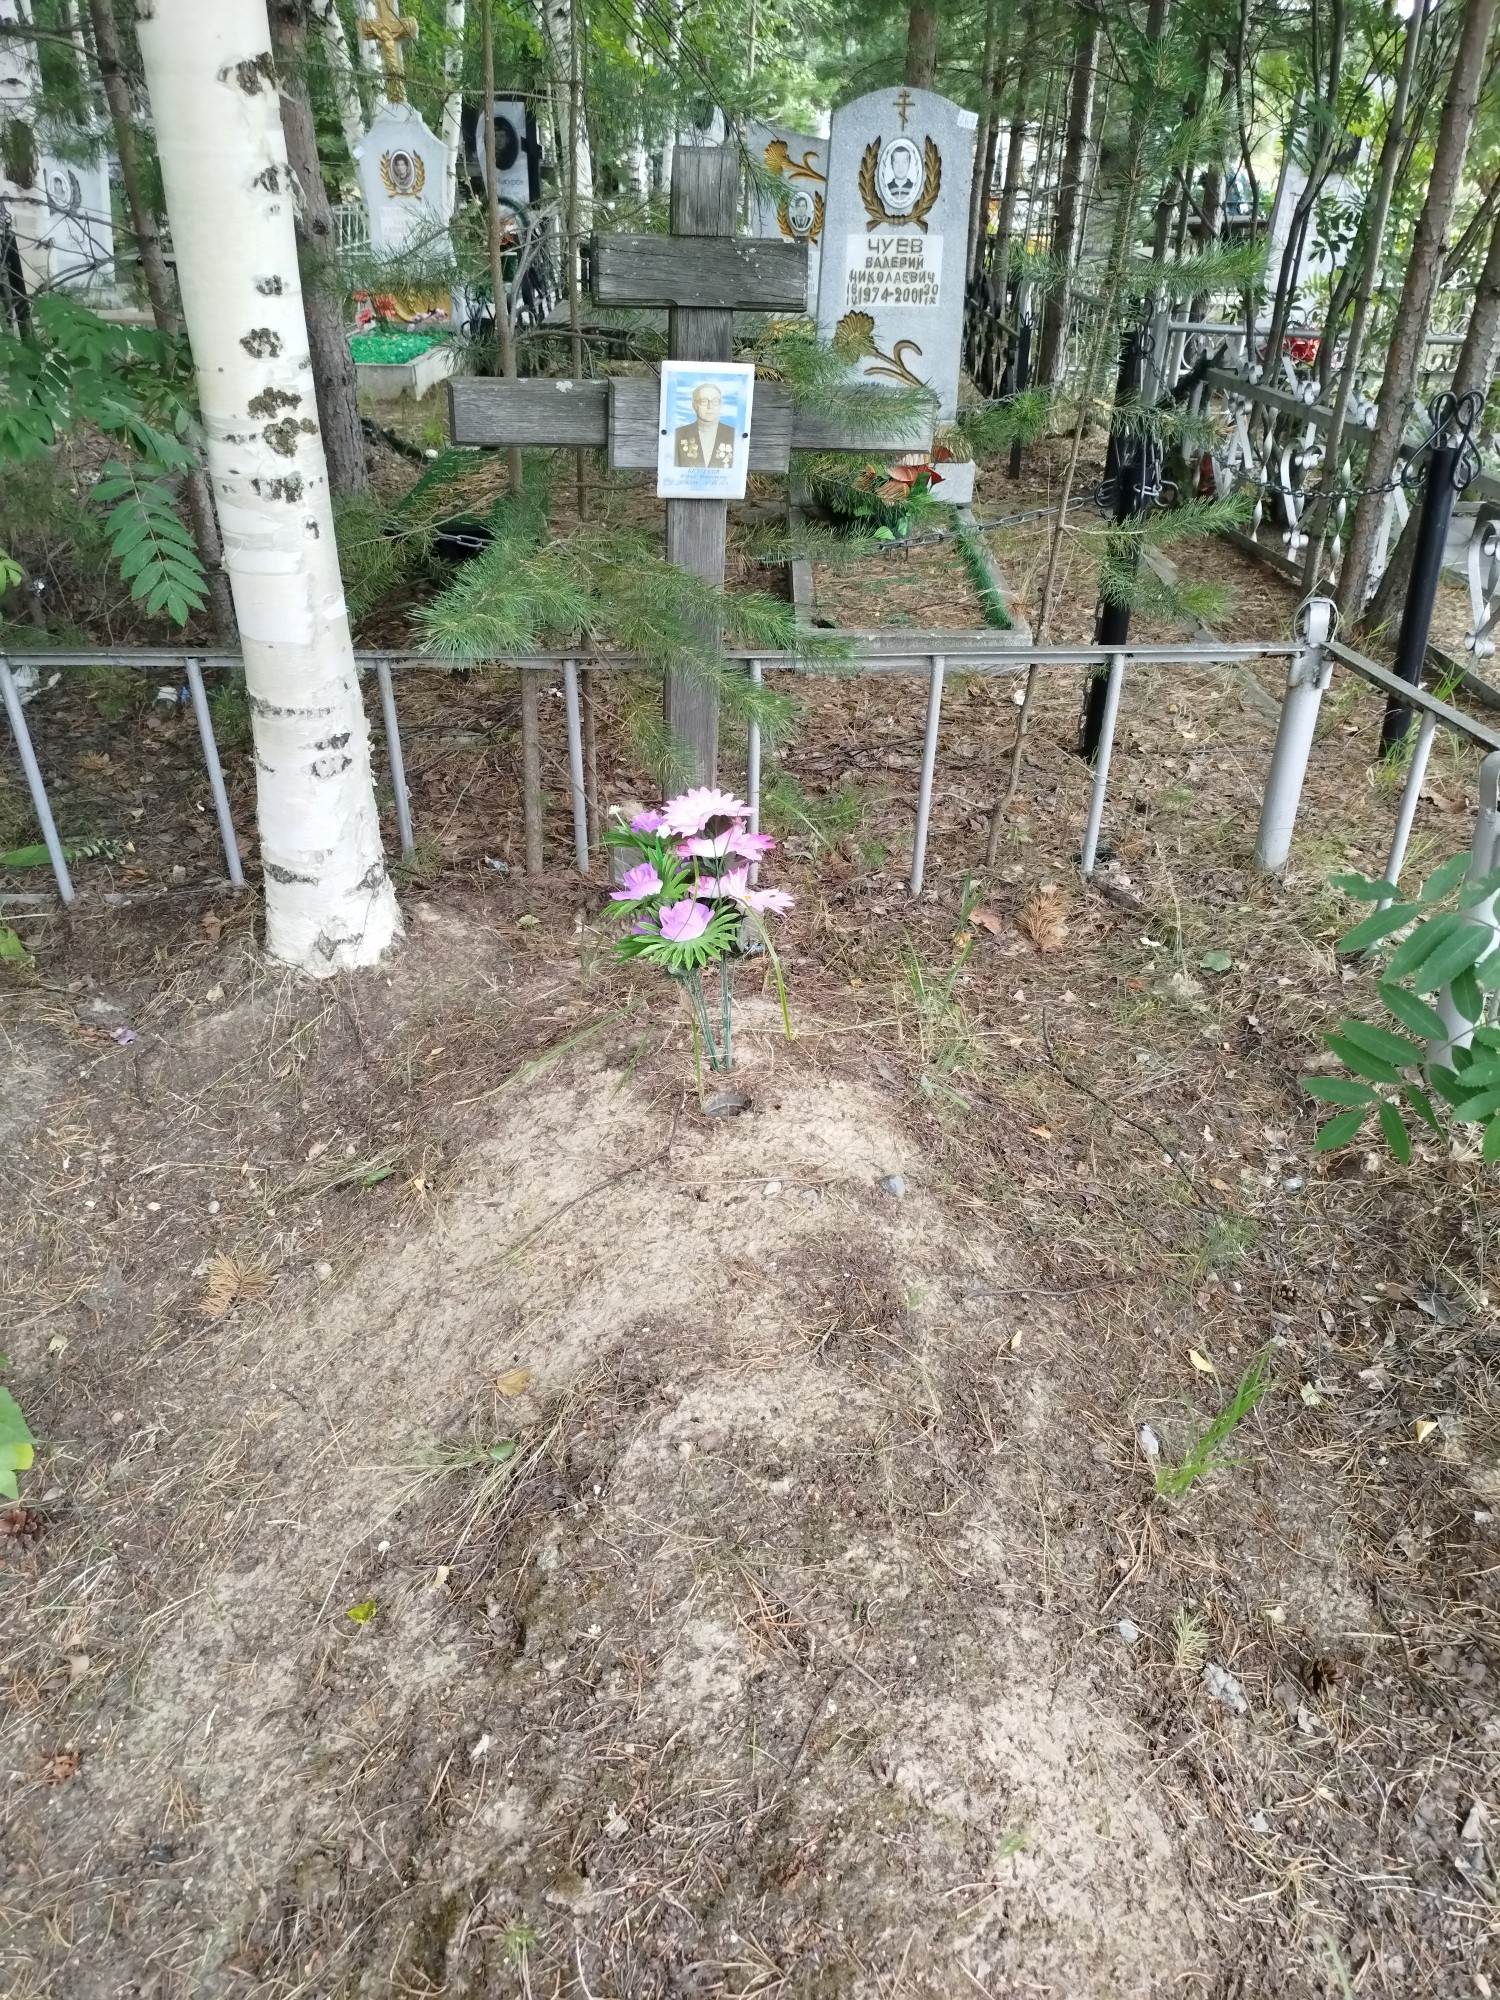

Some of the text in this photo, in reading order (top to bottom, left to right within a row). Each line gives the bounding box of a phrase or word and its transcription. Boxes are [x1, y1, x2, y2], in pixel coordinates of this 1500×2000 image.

[868, 238, 923, 254] ЧУЕВ
[865, 254, 924, 270] ВАЛЕРИЙ
[849, 269, 935, 285] НИКОЛАЕВИЧ
